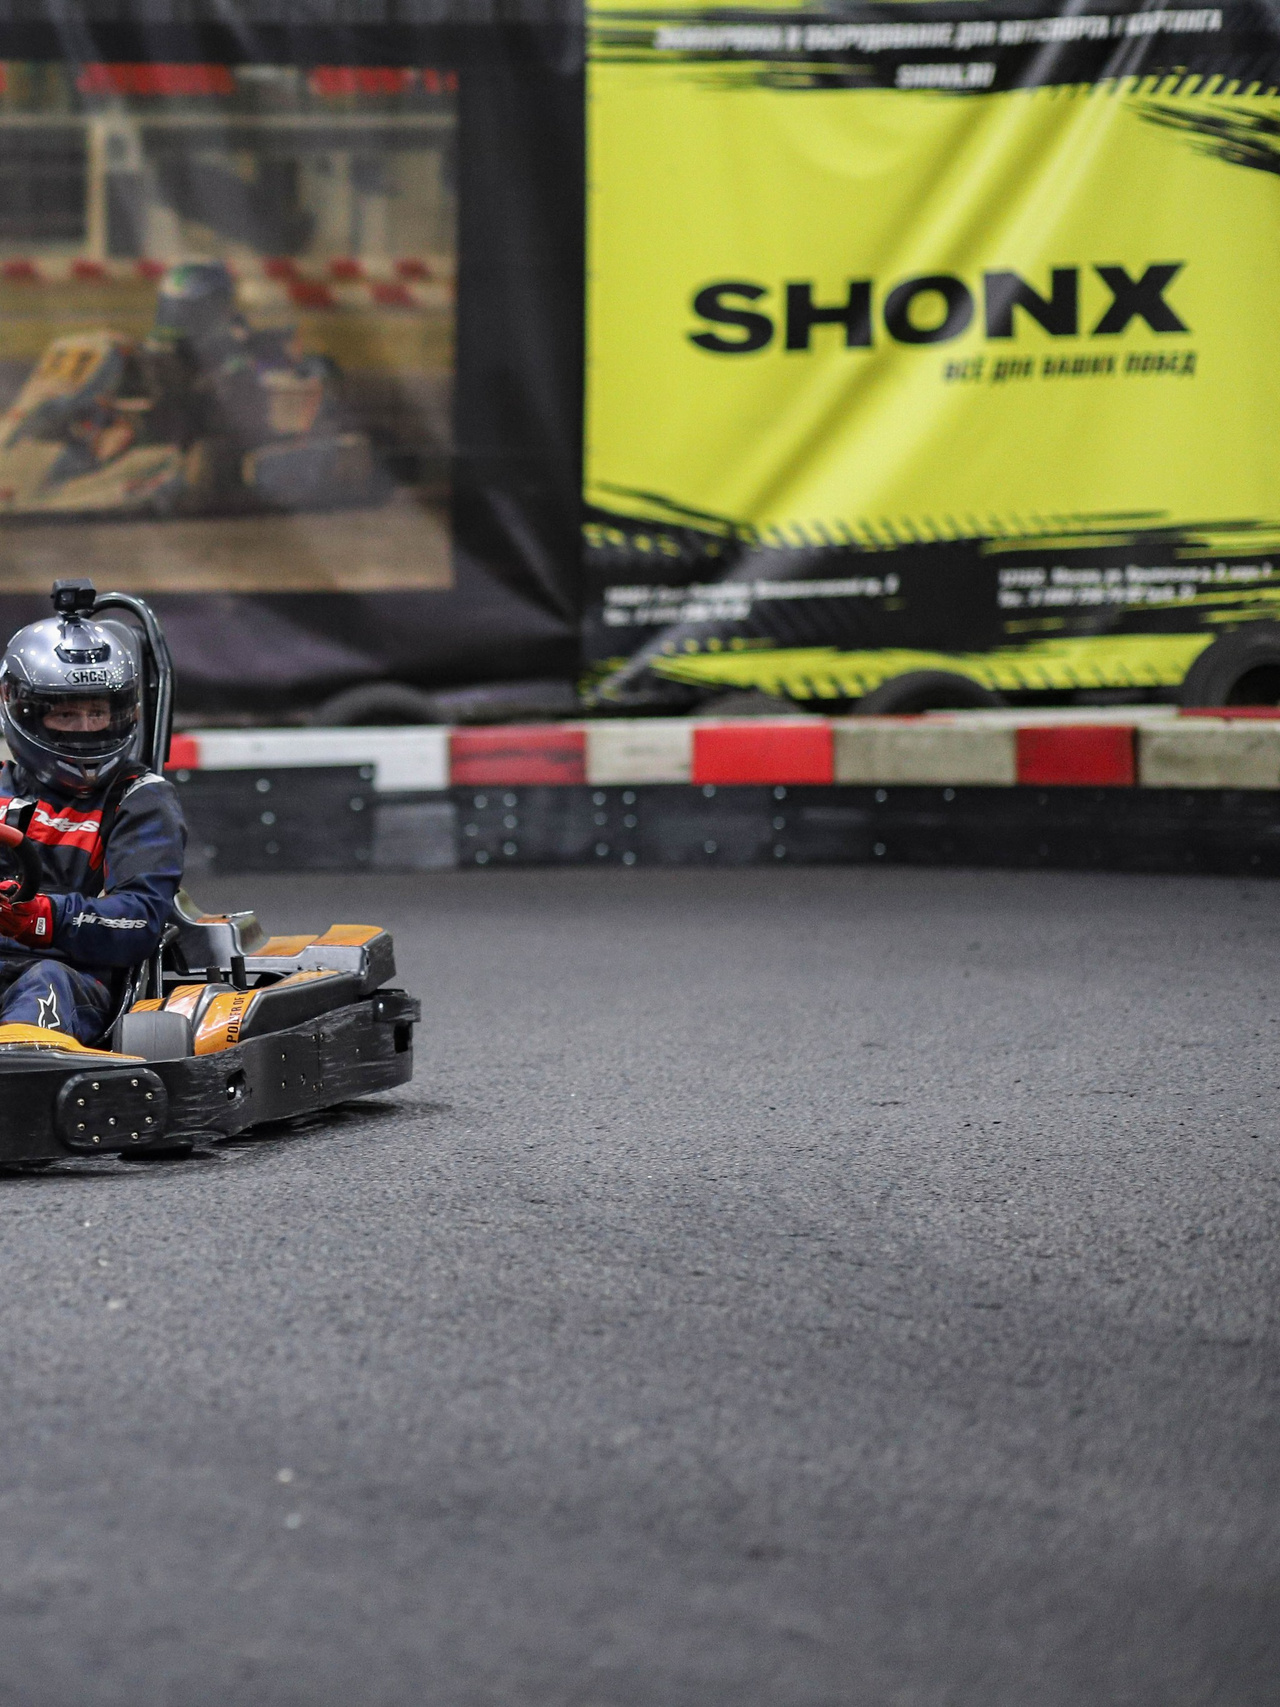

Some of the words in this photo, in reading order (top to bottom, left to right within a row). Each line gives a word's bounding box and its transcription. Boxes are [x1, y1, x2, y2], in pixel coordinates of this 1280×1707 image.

[686, 261, 1190, 354] SHONX
[992, 355, 1034, 384] ДЛЯ
[1043, 354, 1115, 377] ВАШИХ
[1126, 350, 1197, 378] ПОБЕД
